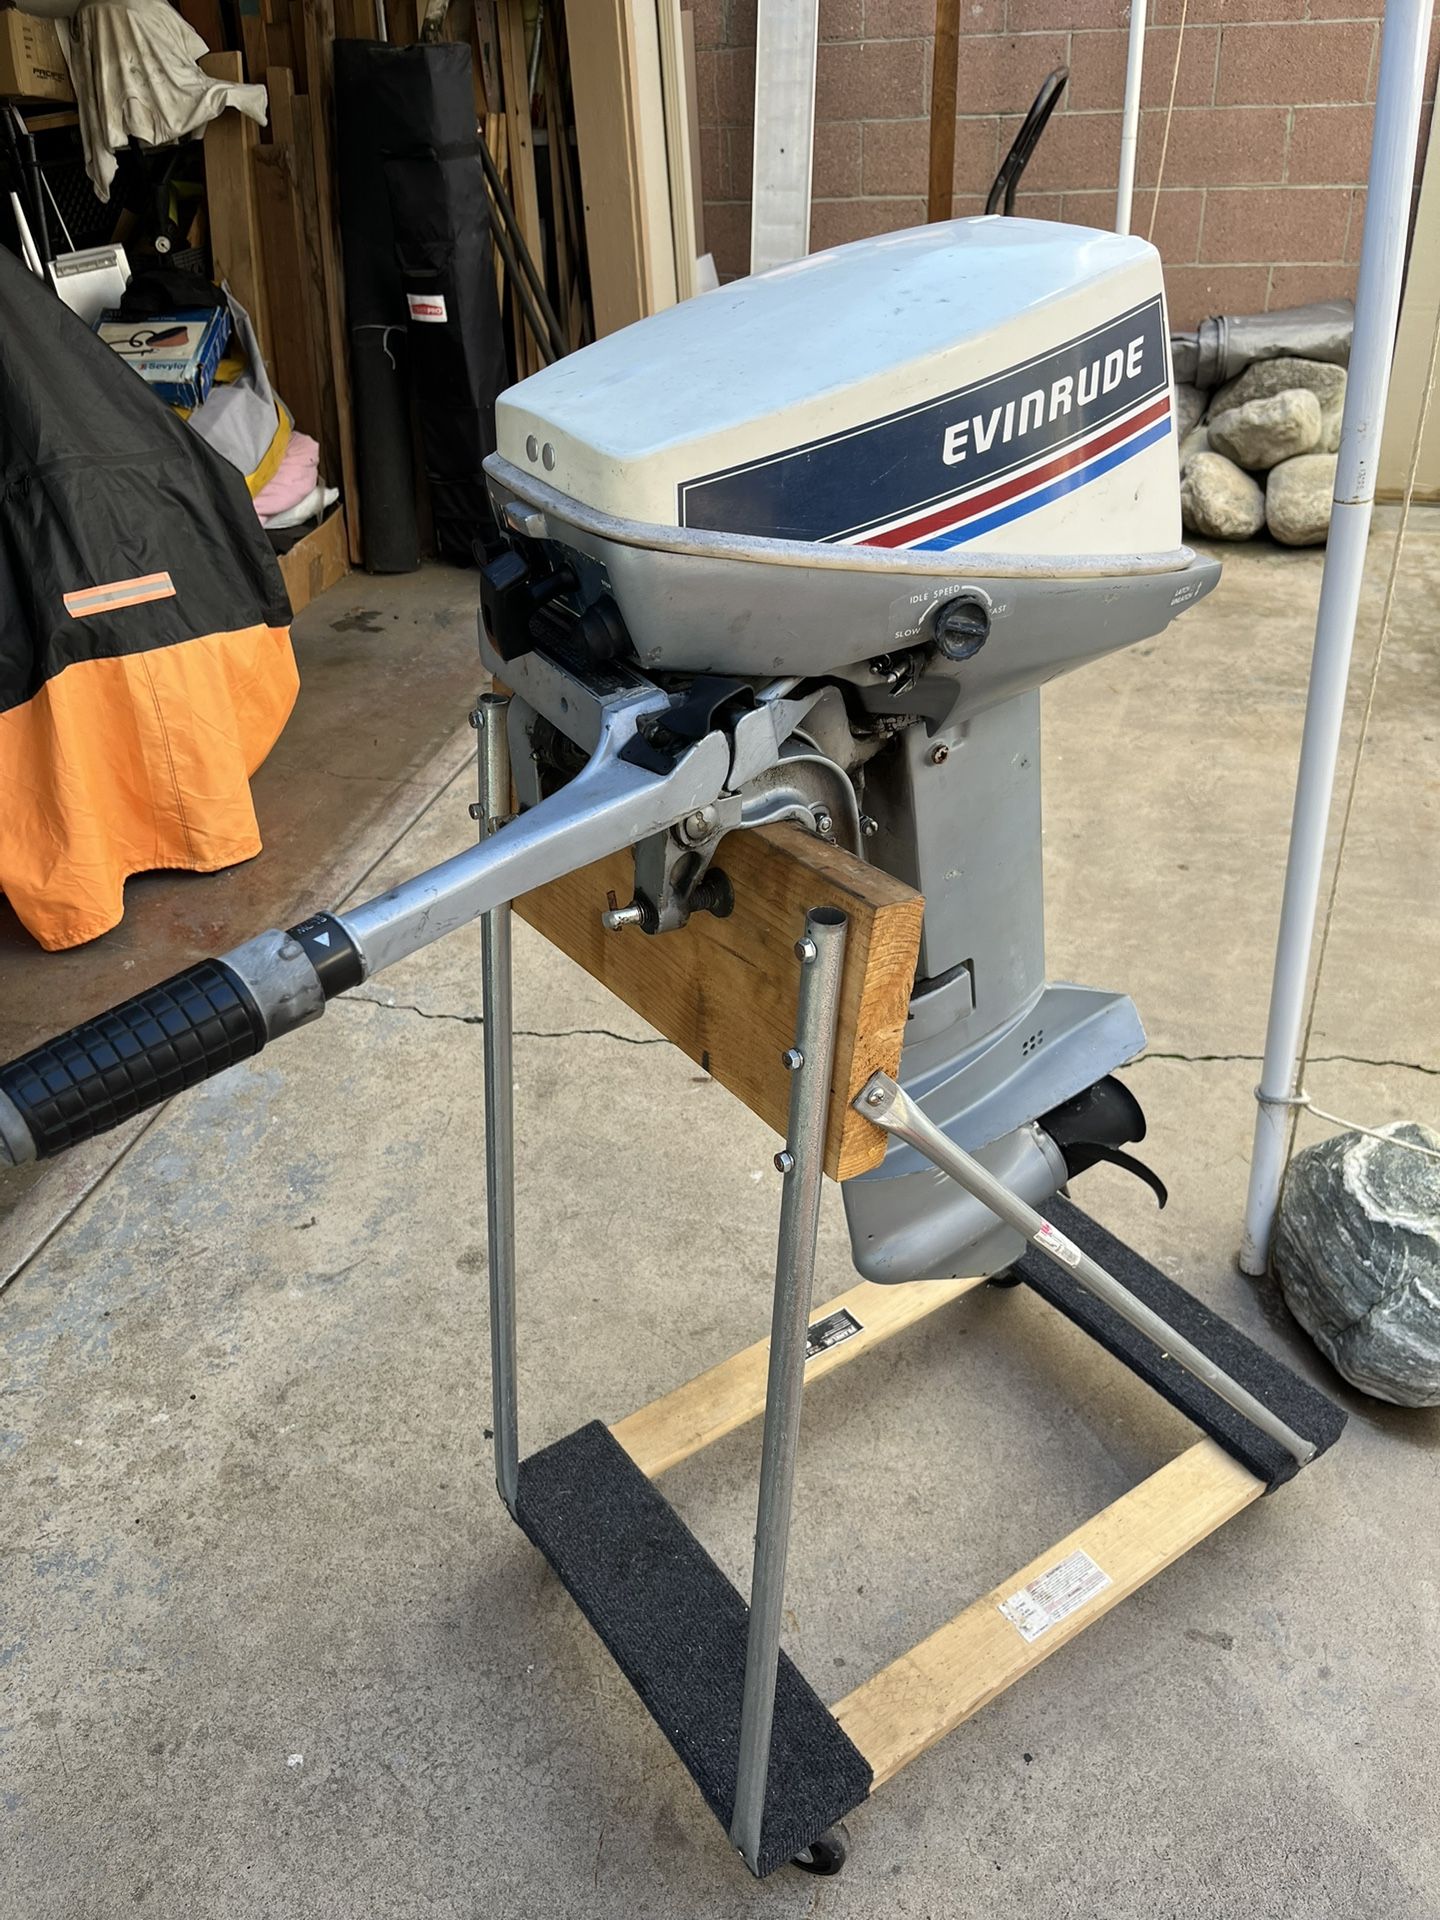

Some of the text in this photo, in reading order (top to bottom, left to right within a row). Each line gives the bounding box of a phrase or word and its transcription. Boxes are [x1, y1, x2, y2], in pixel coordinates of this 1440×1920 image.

[942, 335, 1145, 466] EVINRUDE
[909, 584, 960, 604] IDLE SPEED
[894, 627, 921, 639] SLOW
